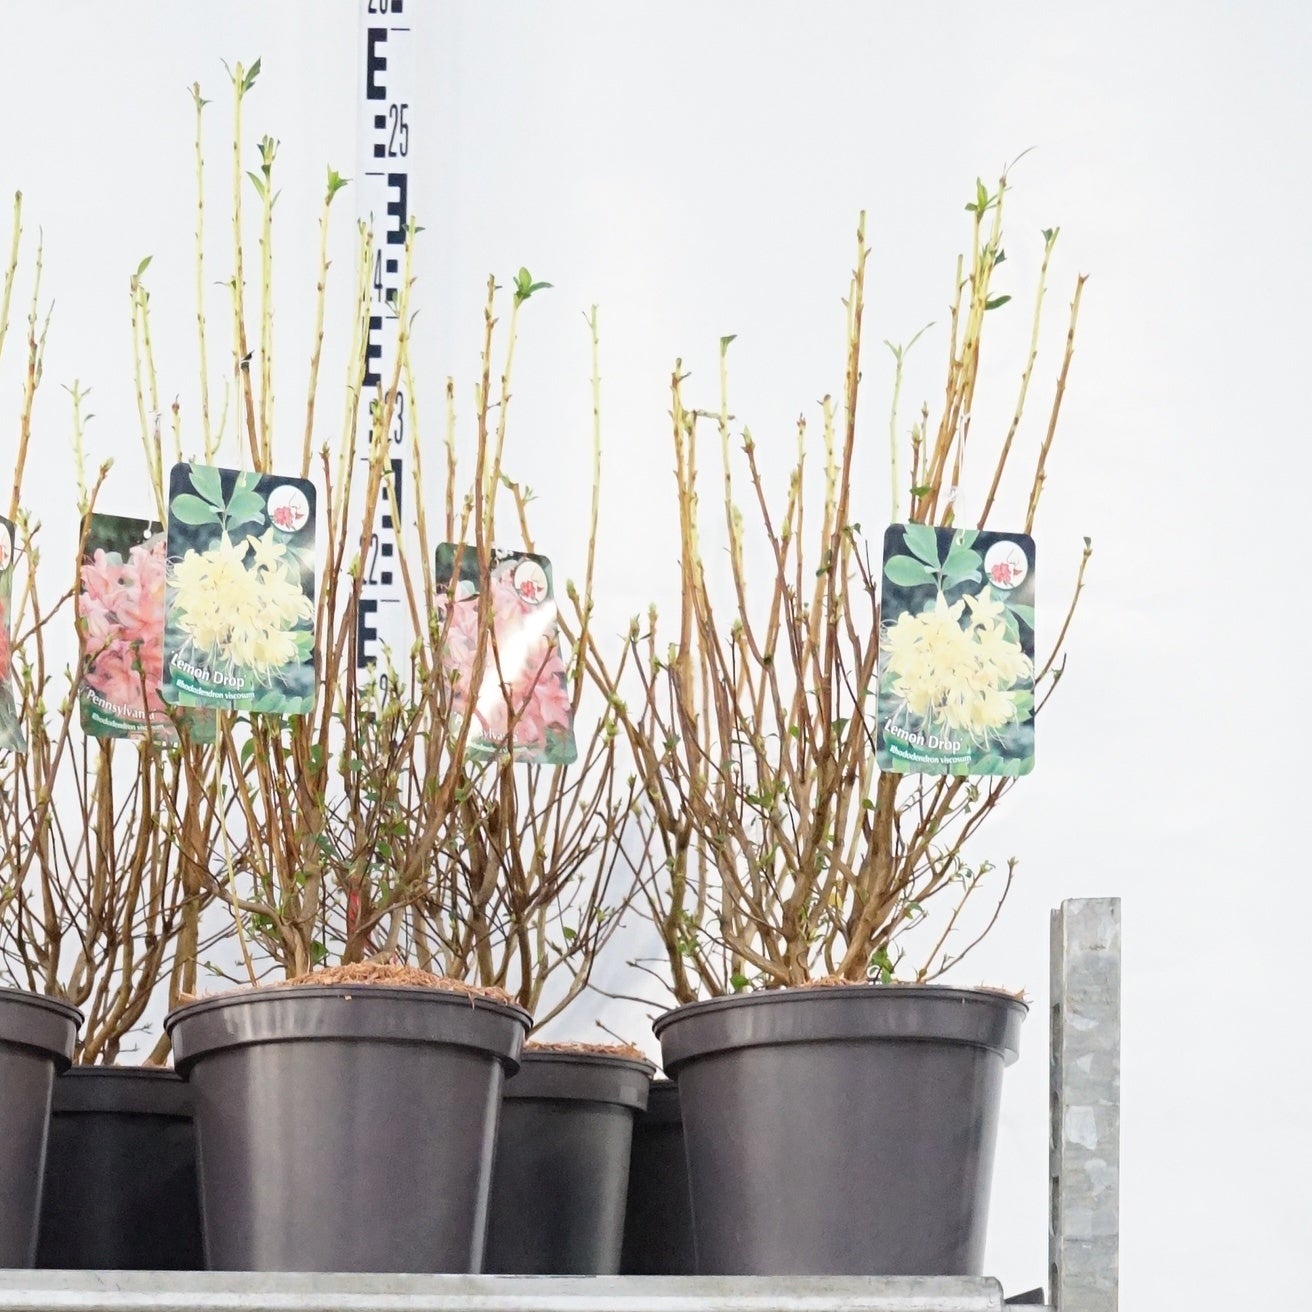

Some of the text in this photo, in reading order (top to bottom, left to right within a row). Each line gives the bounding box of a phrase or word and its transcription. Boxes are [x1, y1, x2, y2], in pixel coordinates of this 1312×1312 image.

[388, 103, 409, 157] 25
[171, 650, 210, 681] 'Lemon
[884, 716, 924, 746] 'Lemon
